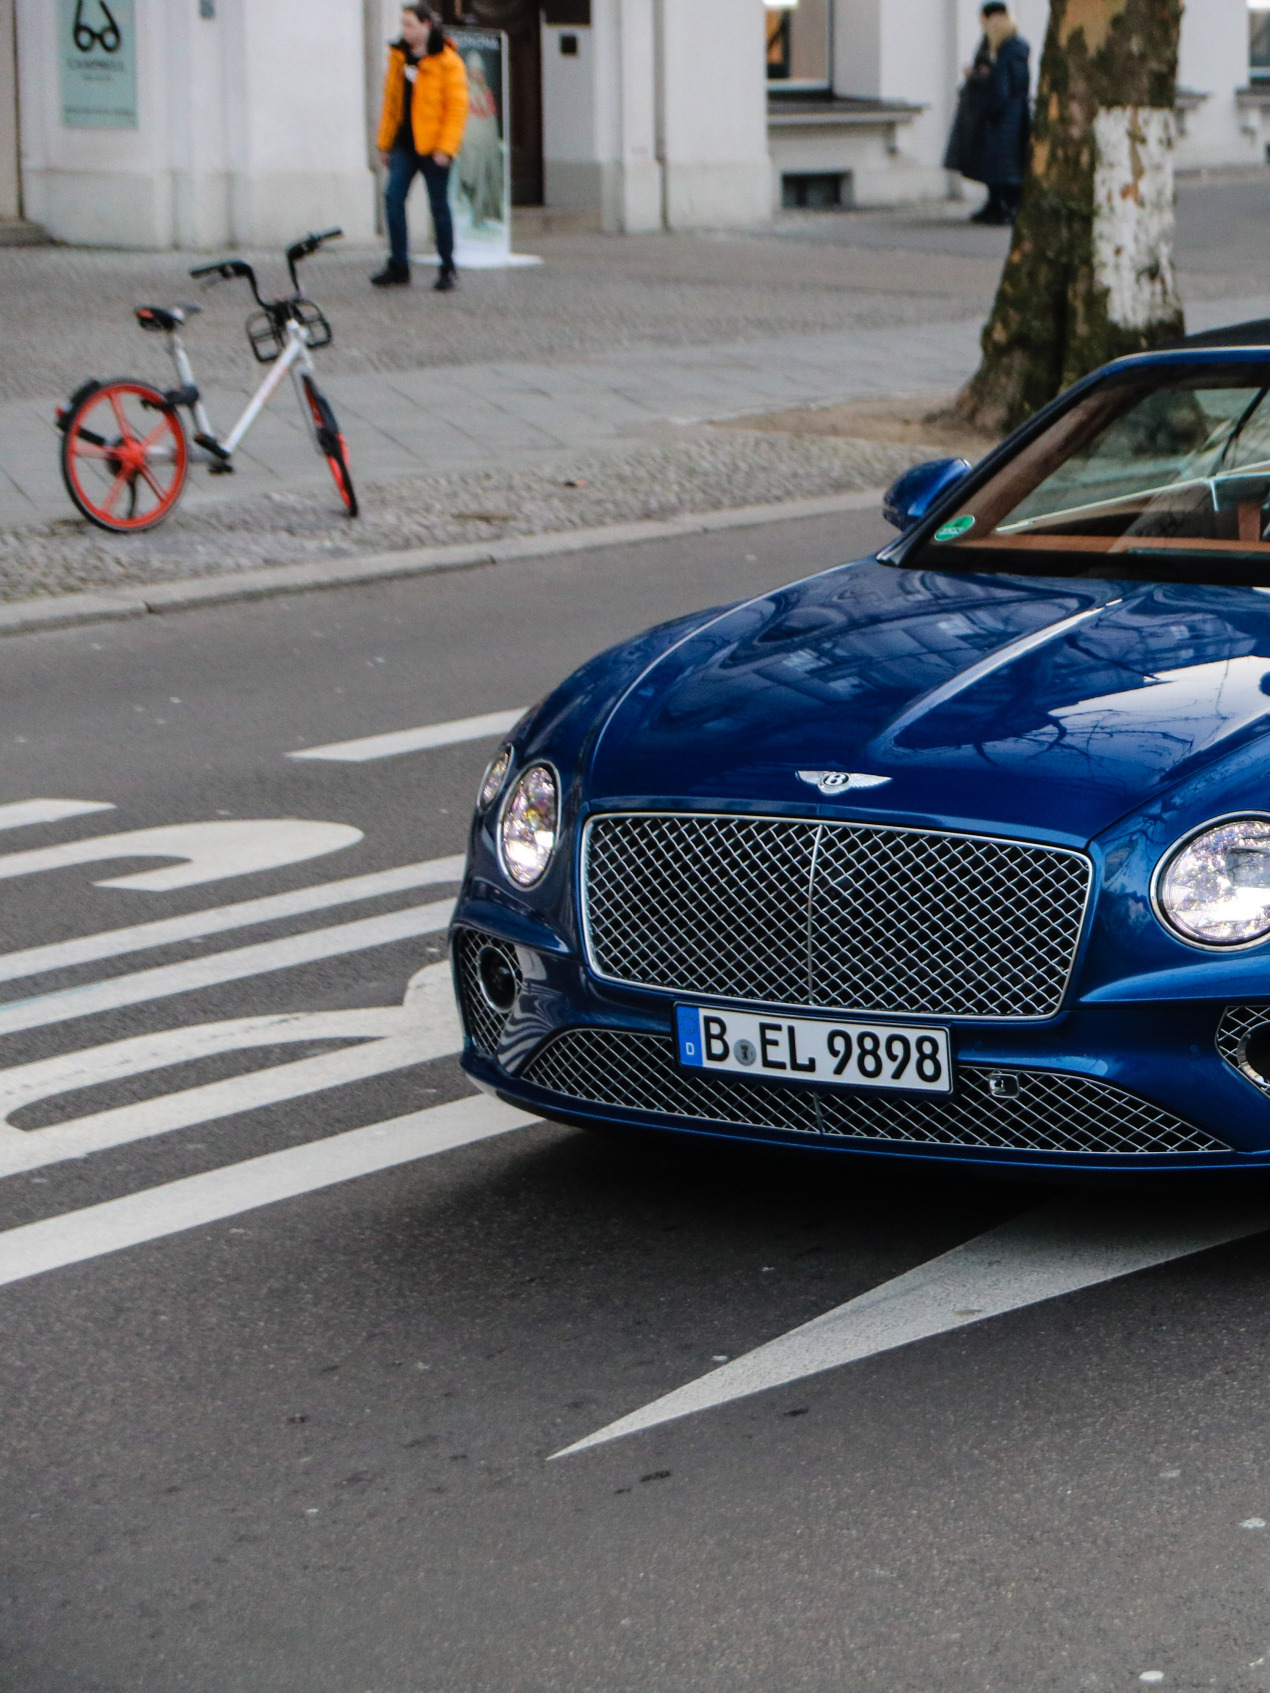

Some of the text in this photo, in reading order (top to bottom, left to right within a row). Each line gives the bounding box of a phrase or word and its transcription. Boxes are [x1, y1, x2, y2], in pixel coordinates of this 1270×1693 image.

[686, 1015, 943, 1083] D B EL 9898
